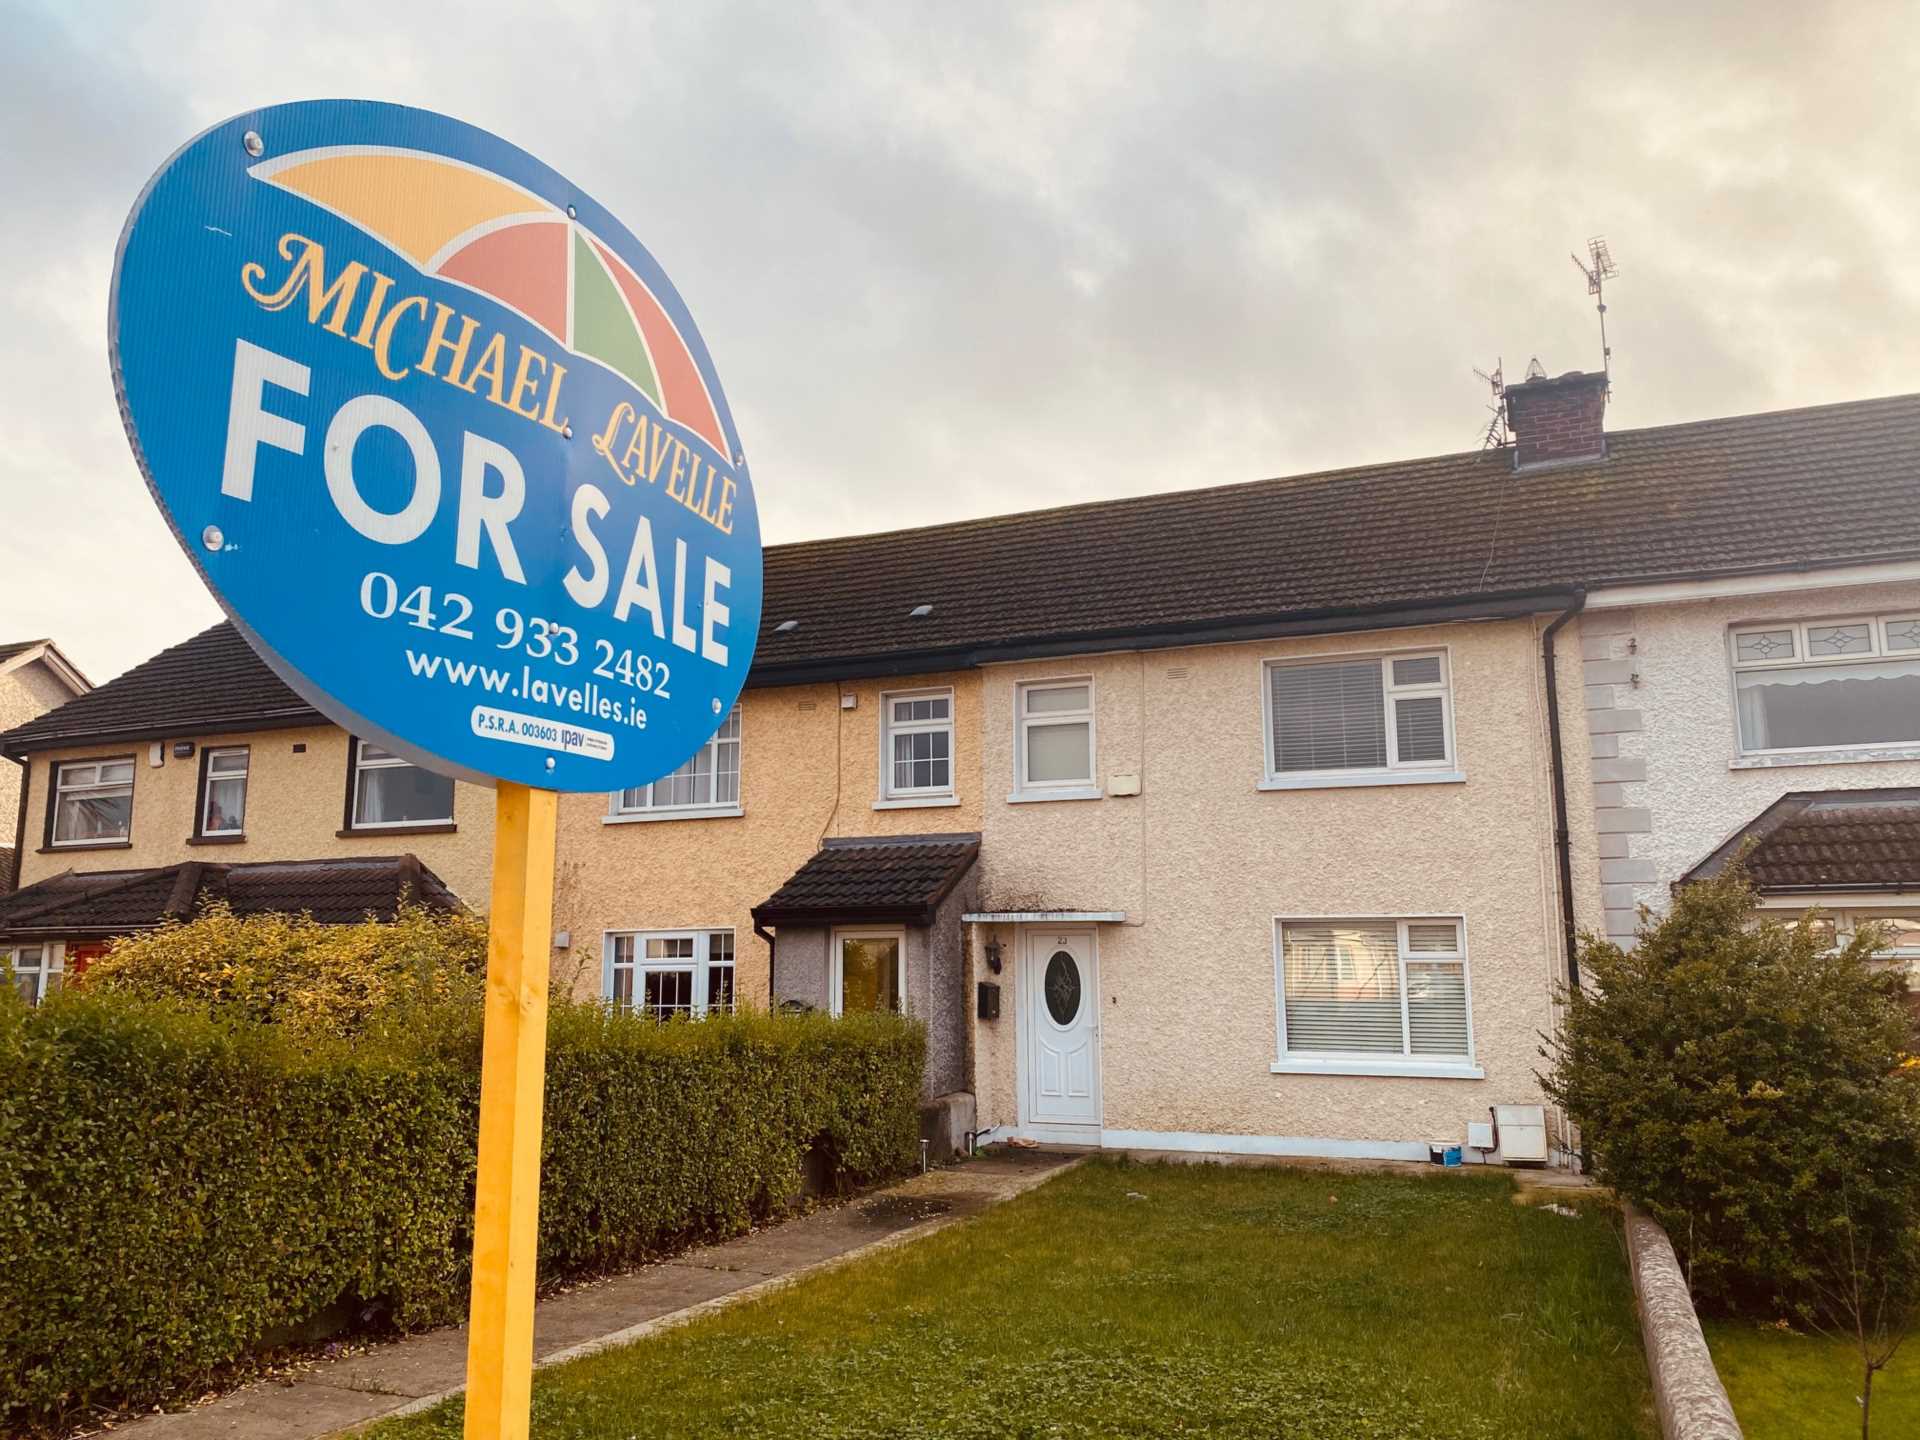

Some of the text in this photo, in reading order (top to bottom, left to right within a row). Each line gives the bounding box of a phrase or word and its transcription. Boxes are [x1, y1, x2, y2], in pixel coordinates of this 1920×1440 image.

[241, 233, 737, 536] MICHAEL LAVELLE
[221, 338, 731, 667] FOR SALE
[360, 571, 671, 699] 042 933 2482
[405, 649, 647, 729] www.lavelles.ie
[477, 712, 519, 734] P.S.R.A.
[522, 722, 557, 742] 003603
